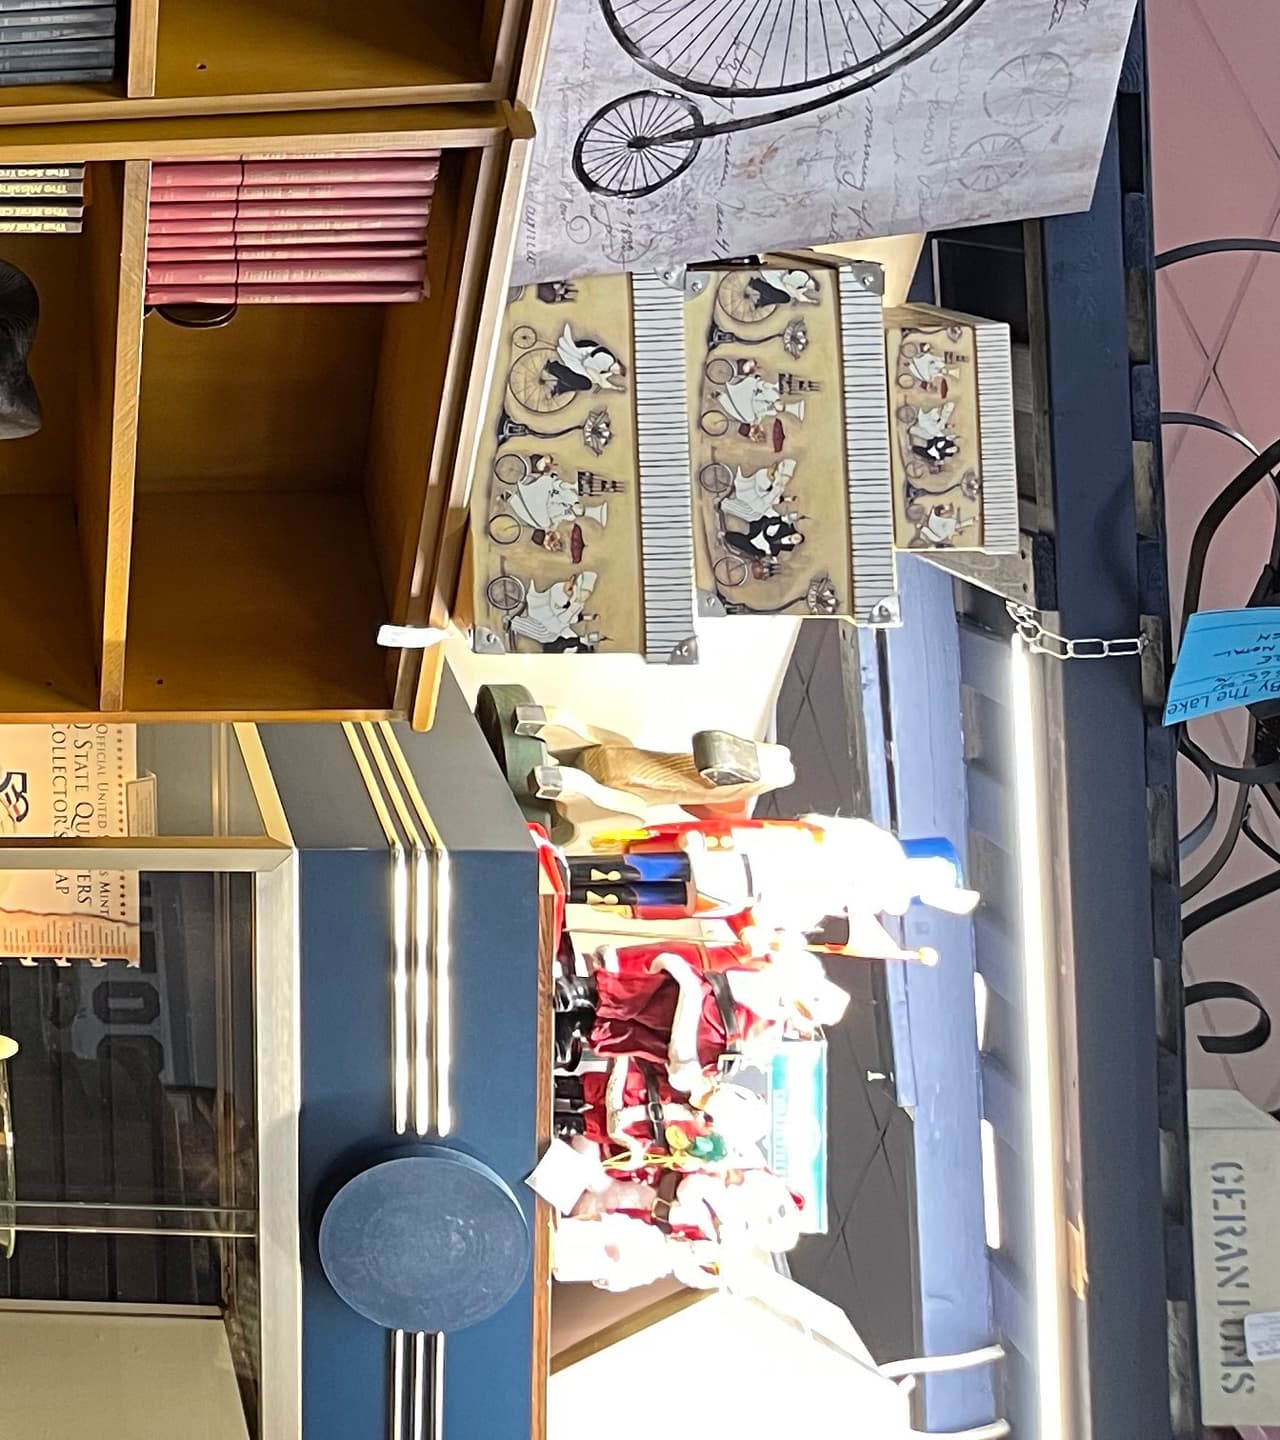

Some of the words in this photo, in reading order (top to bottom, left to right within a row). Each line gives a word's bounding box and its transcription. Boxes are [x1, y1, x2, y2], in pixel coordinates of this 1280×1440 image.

[43, 184, 68, 194] The
[45, 169, 70, 177] The
[1168, 696, 1209, 715] Lake
[1216, 686, 1249, 701] The
[74, 739, 93, 792] STATE
[96, 724, 109, 776] OFFICIAL
[97, 782, 109, 828] UNITED
[100, 881, 111, 915] MINT
[1211, 1162, 1255, 1394] GERANIUMS
